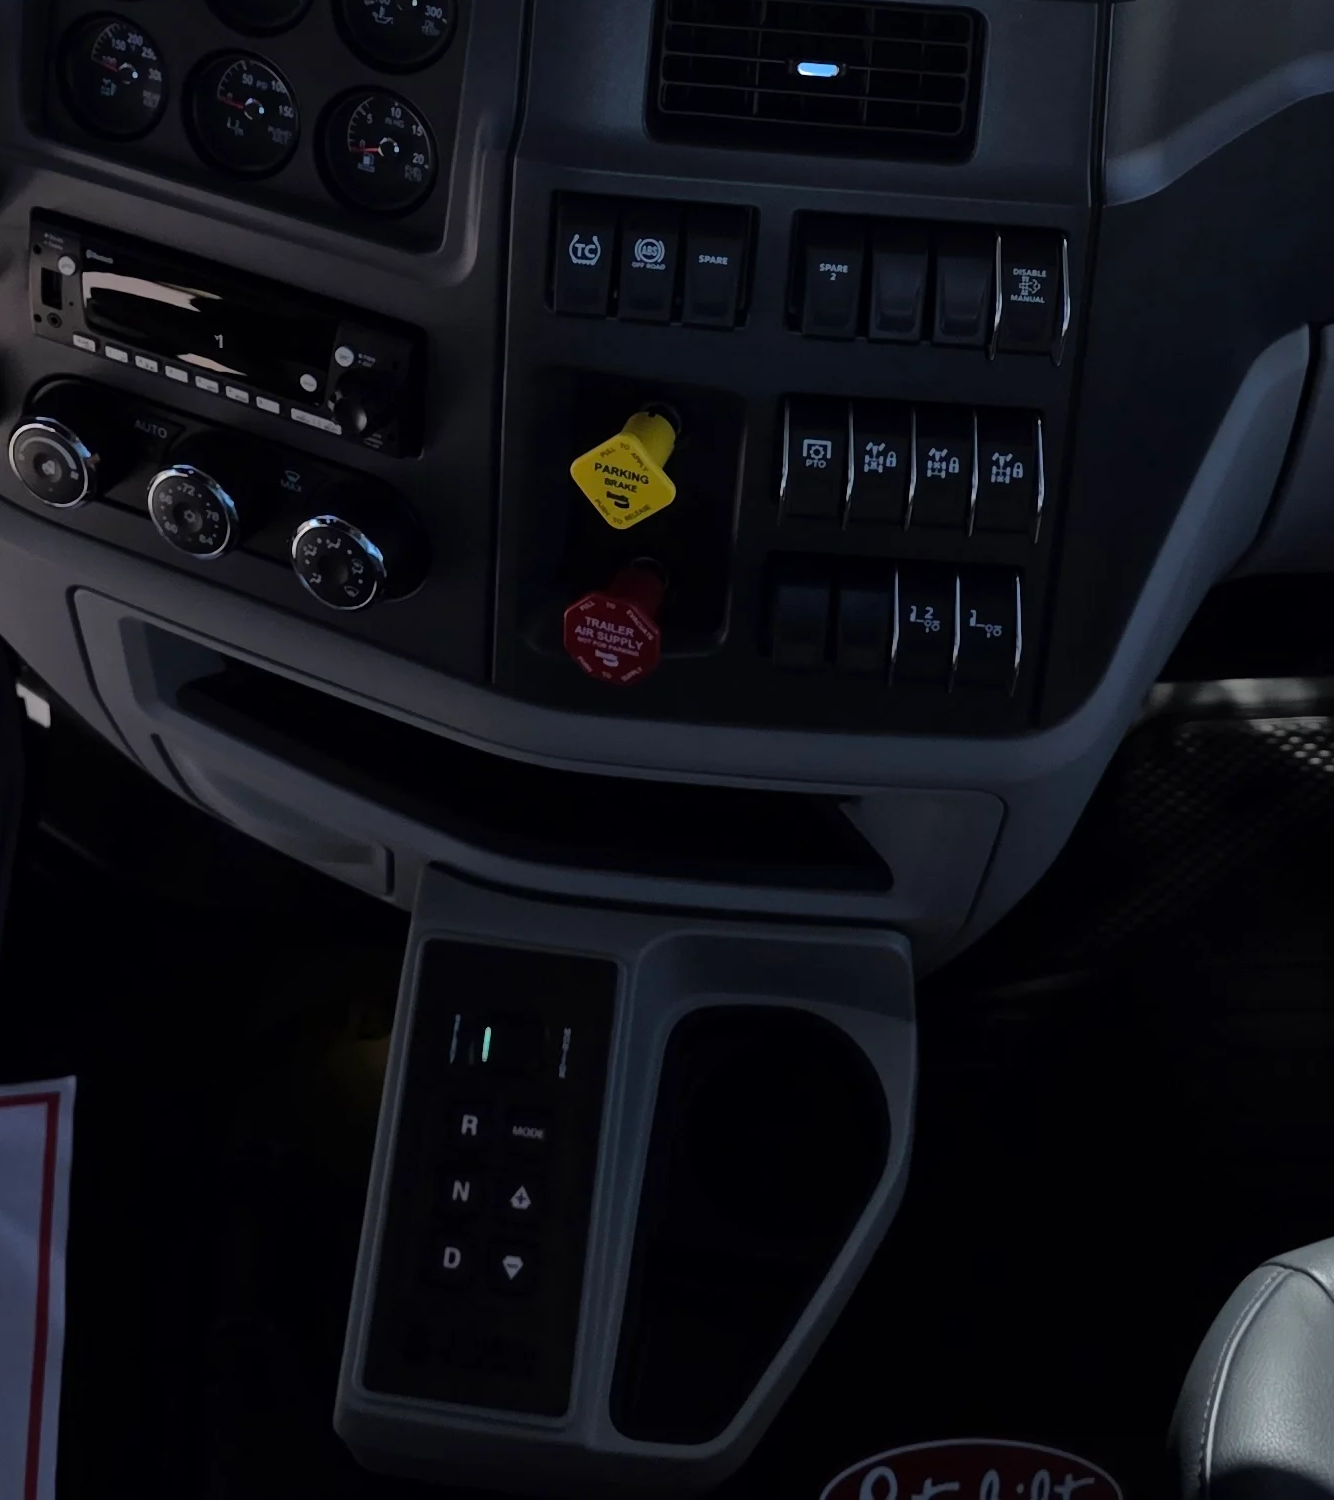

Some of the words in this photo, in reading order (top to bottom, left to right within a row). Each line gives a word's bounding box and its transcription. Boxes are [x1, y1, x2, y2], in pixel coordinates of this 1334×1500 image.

[424, 4, 444, 19] 300
[111, 37, 128, 52] 150
[241, 72, 254, 86] 50
[366, 112, 374, 125] 5
[390, 106, 402, 119] 10
[412, 124, 425, 137] 15
[412, 152, 426, 166] 20
[574, 243, 597, 258] TC
[642, 244, 659, 257] ABS
[631, 260, 645, 269] OFF
[698, 254, 729, 266] SPARE
[819, 262, 849, 274] SPARE
[1012, 267, 1048, 278] DISABLE
[829, 272, 837, 281] 2
[1010, 294, 1046, 304] MANUAL
[134, 418, 168, 439] AUTO
[805, 458, 827, 469] PTO
[594, 461, 650, 485] PARKING
[604, 477, 638, 494] BRAKE
[924, 606, 935, 619] 2
[585, 615, 635, 637] TRAILER
[574, 624, 595, 639] AIR
[596, 631, 644, 651] SUPPLY
[460, 1113, 479, 1137] R
[512, 1124, 547, 1140] MODE
[451, 1179, 471, 1203] N
[442, 1244, 463, 1270] D
